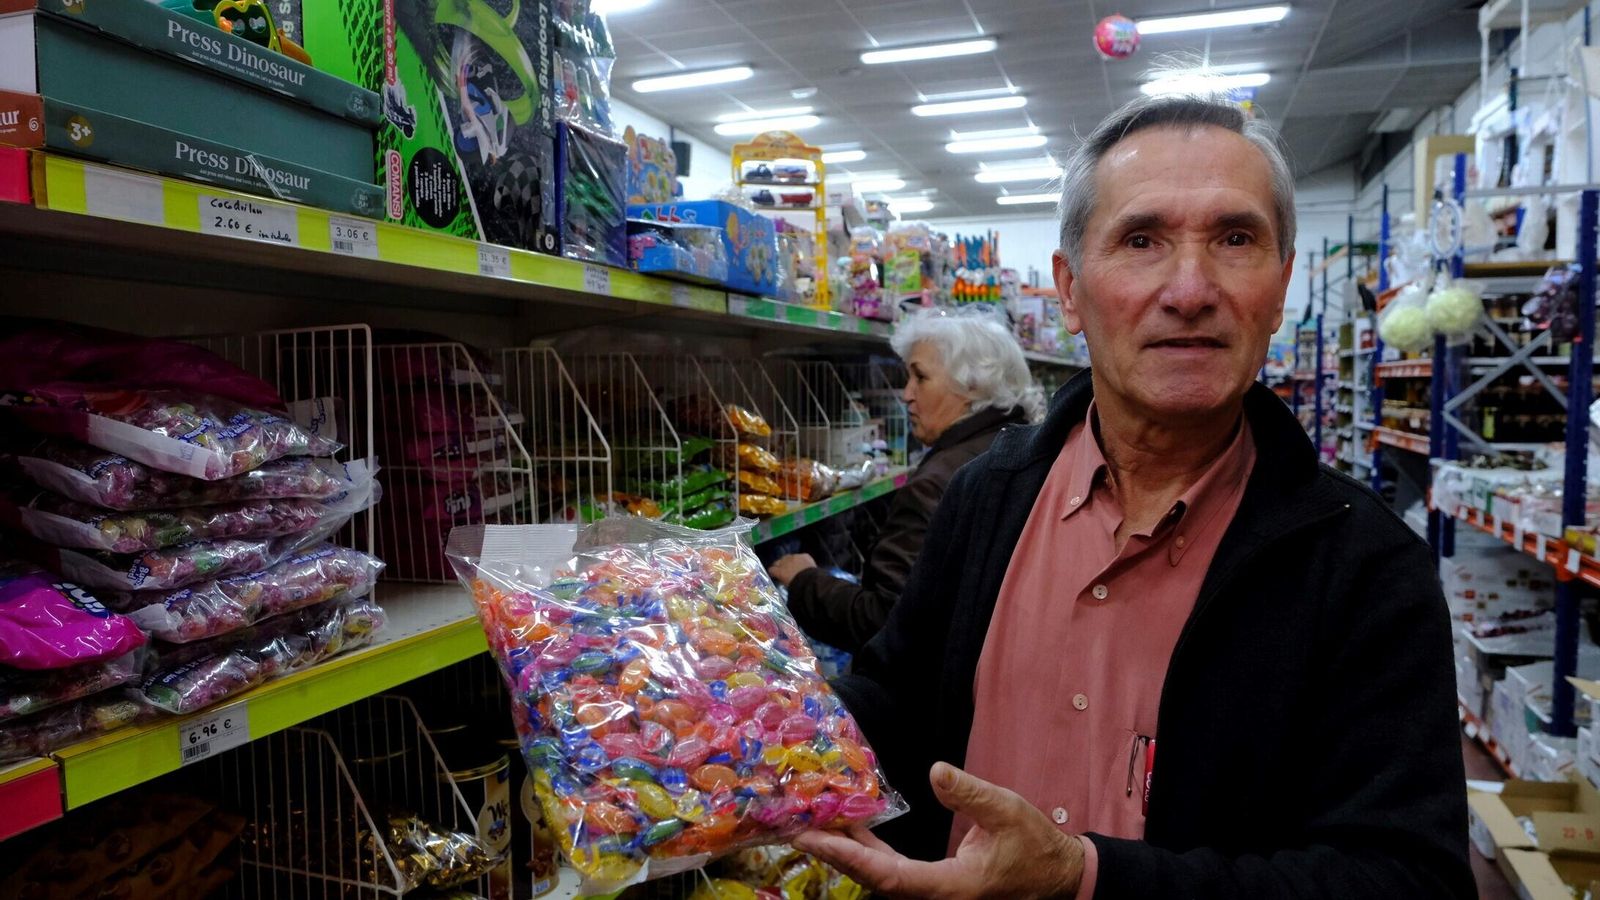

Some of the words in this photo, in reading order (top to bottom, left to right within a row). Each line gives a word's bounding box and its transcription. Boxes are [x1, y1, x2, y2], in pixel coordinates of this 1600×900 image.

[167, 19, 222, 56] Press
[228, 43, 306, 86] Dinosaur
[538, 3, 549, 89] Looping
[541, 94, 551, 130] Set
[70, 122, 91, 141] 3+
[175, 140, 229, 171] Press
[391, 153, 401, 217] COMANSI
[214, 216, 240, 230] 2.60
[245, 224, 252, 233] €
[336, 226, 359, 239] 3.06
[362, 231, 369, 241] €
[189, 723, 217, 744] 6.96
[223, 718, 232, 729] €
